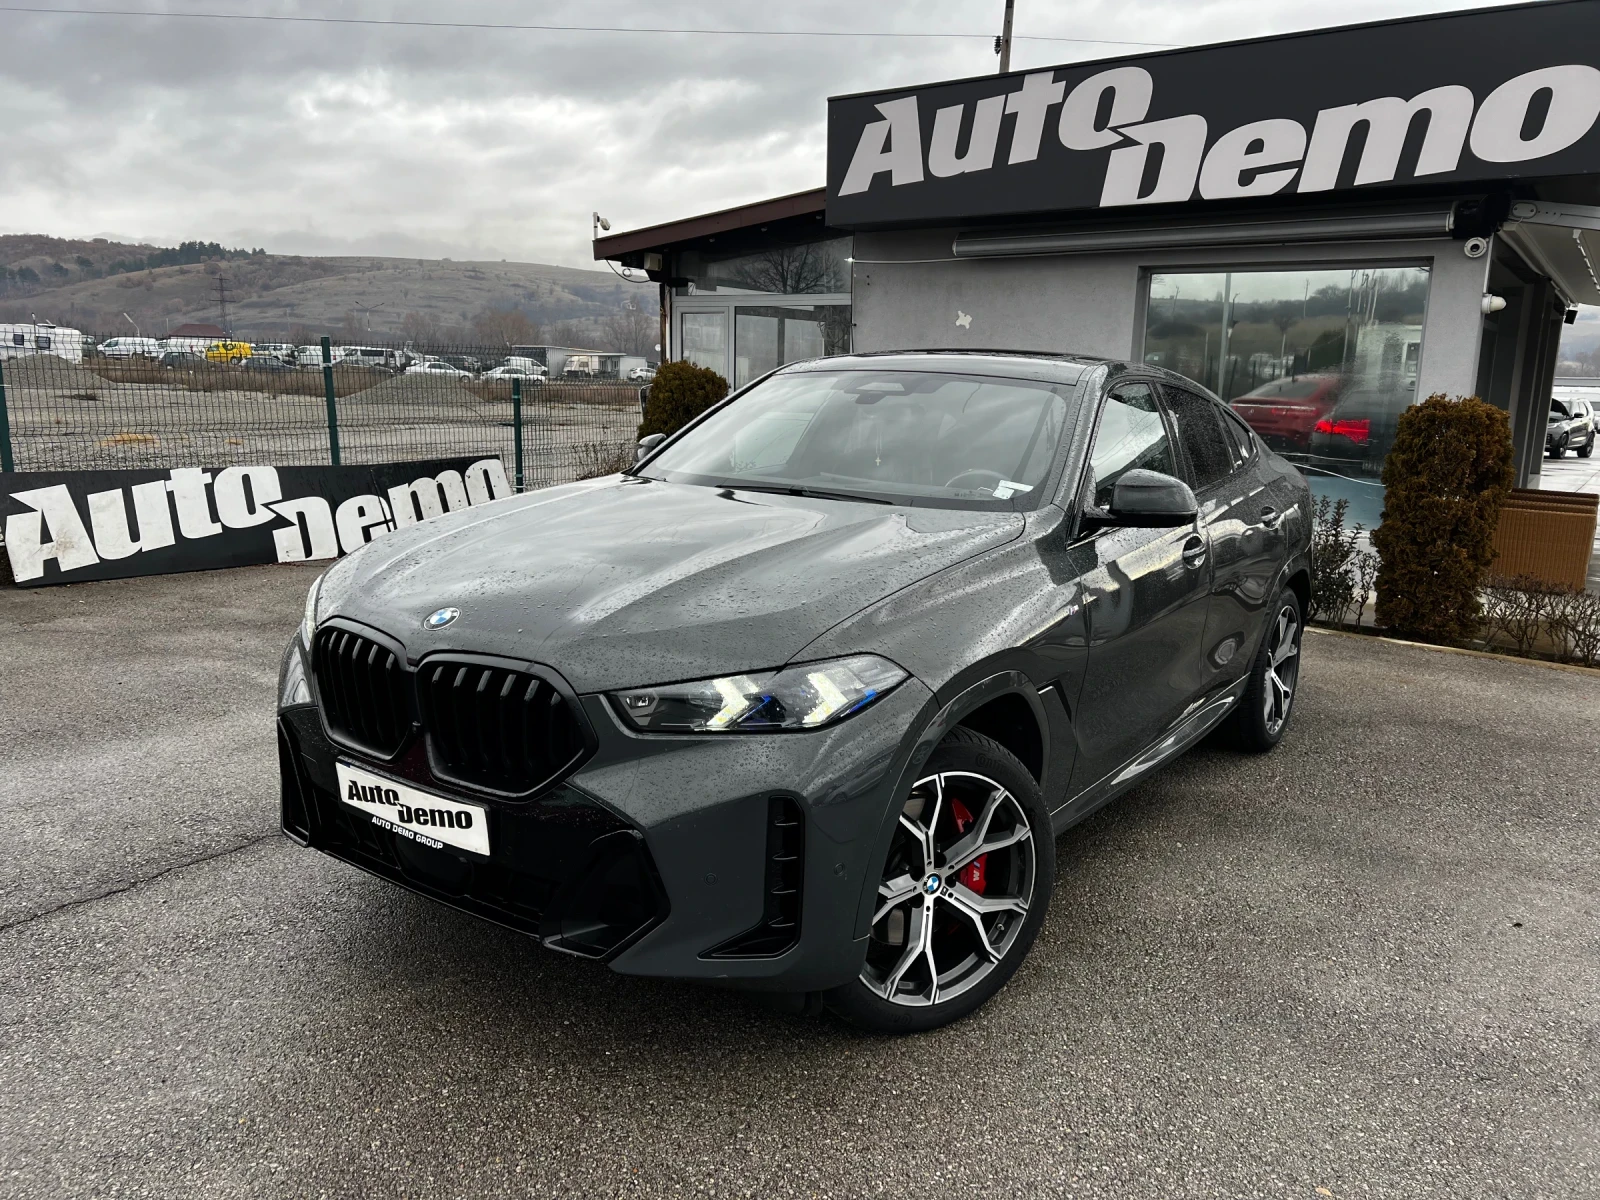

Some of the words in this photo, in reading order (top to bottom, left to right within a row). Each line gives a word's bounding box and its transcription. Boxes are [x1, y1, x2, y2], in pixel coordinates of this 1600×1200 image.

[838, 66, 1154, 197] Auto
[1099, 64, 1600, 207] Demo
[5, 466, 283, 582] Auto
[268, 459, 512, 563] Demo
[348, 780, 401, 806] Auto
[397, 803, 473, 829] Demo
[371, 816, 391, 829] AUTO
[392, 824, 414, 839] DEMO
[415, 834, 444, 850] GROUP
